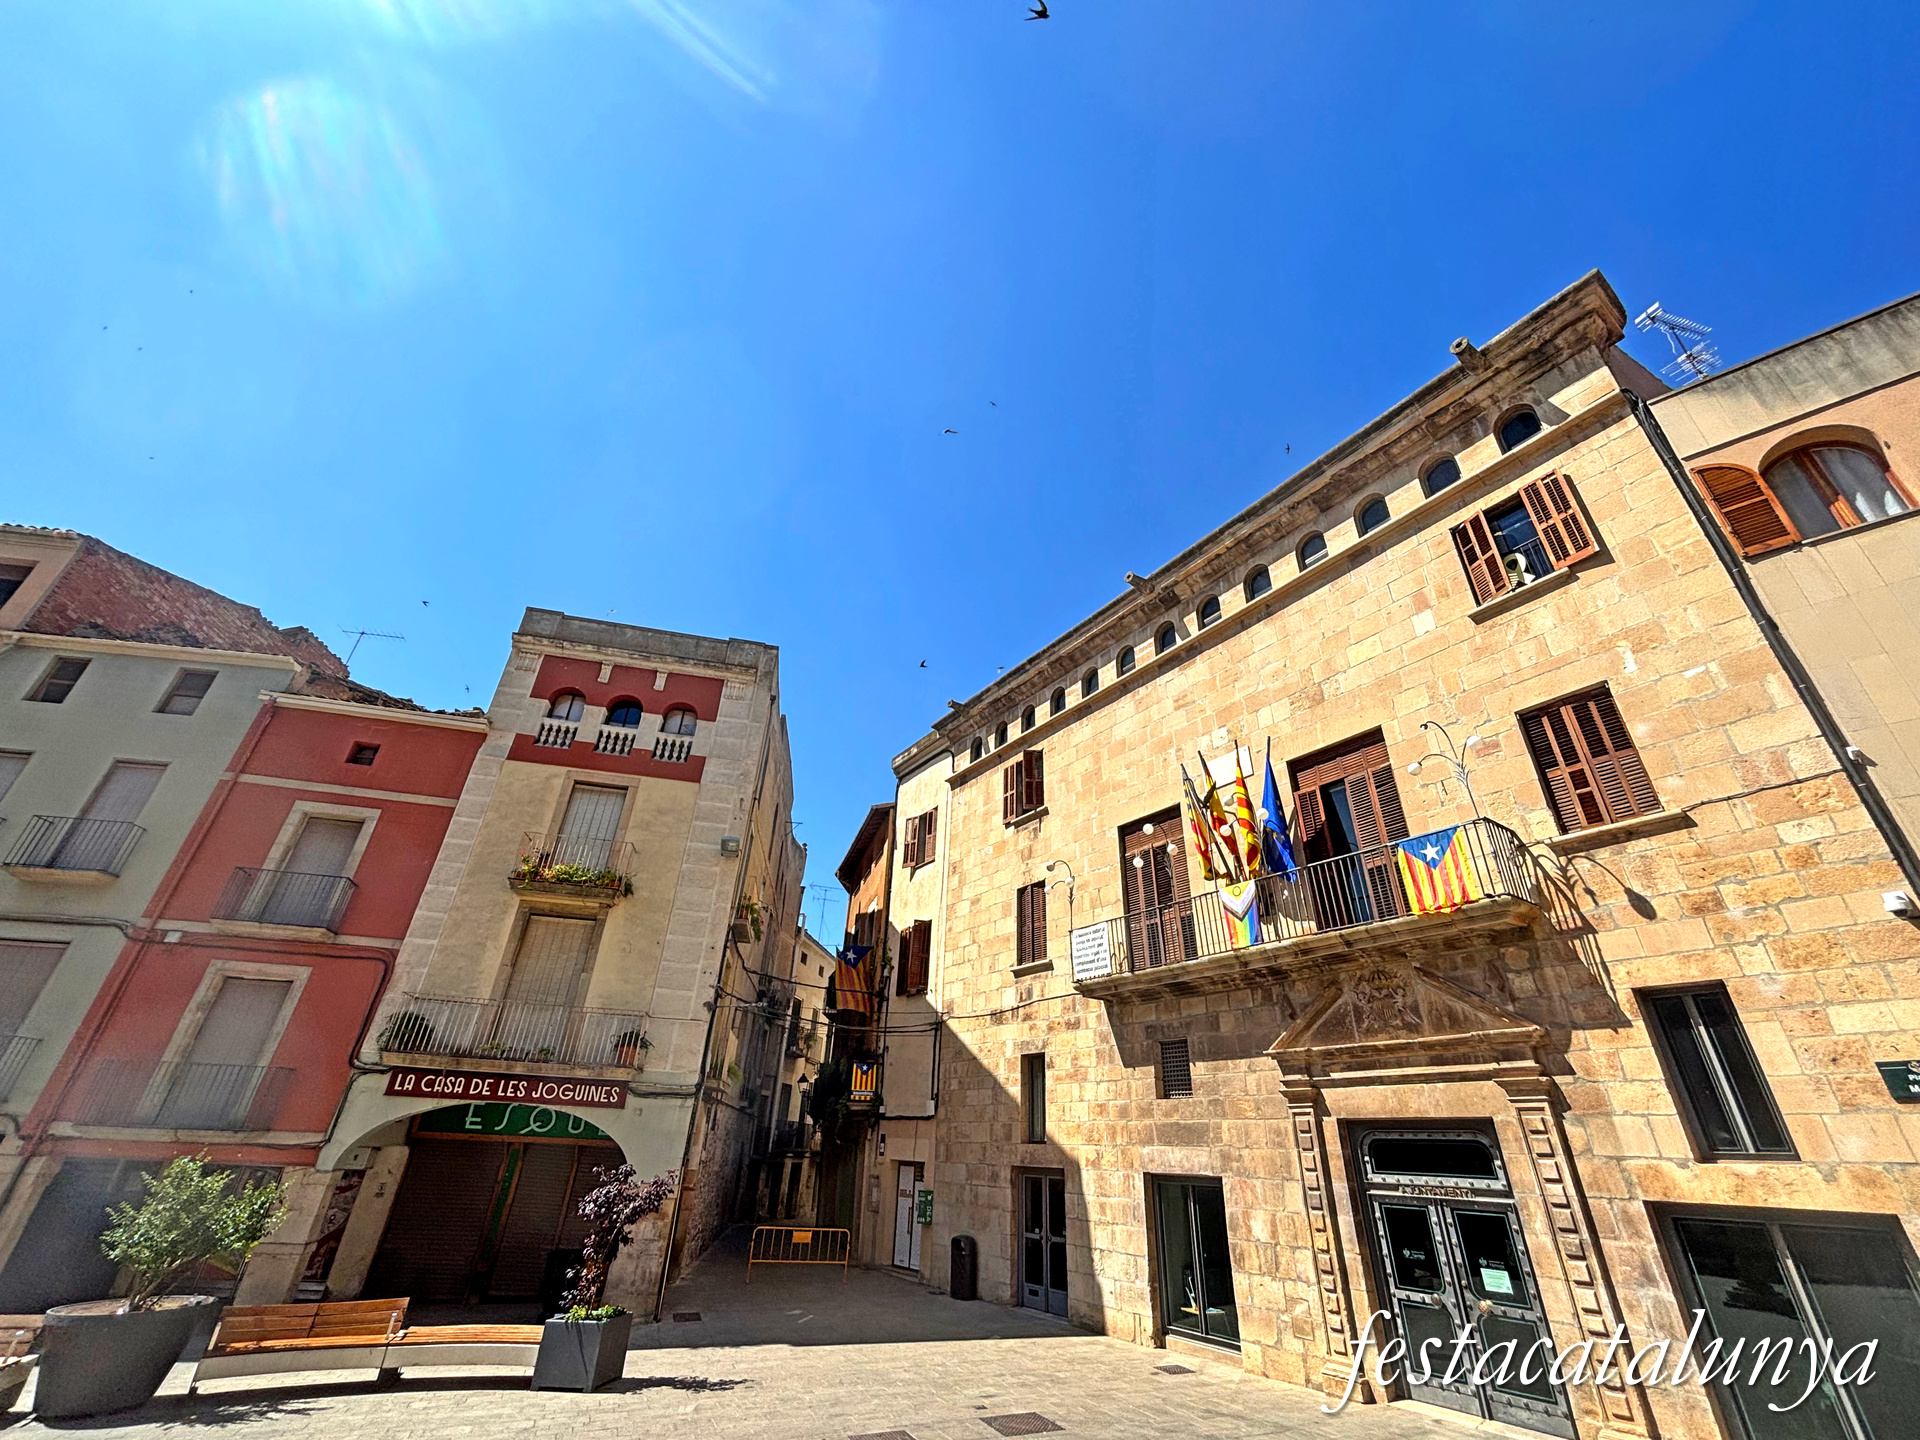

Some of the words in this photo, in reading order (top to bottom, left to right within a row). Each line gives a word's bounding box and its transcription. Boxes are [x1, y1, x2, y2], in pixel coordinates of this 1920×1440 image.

[394, 1073, 416, 1091] LA
[420, 1075, 465, 1094] CASA
[469, 1078, 494, 1095] DE
[497, 1079, 528, 1097] LES
[531, 1082, 620, 1103] JOGUINES
[465, 1102, 607, 1134] ESQU
